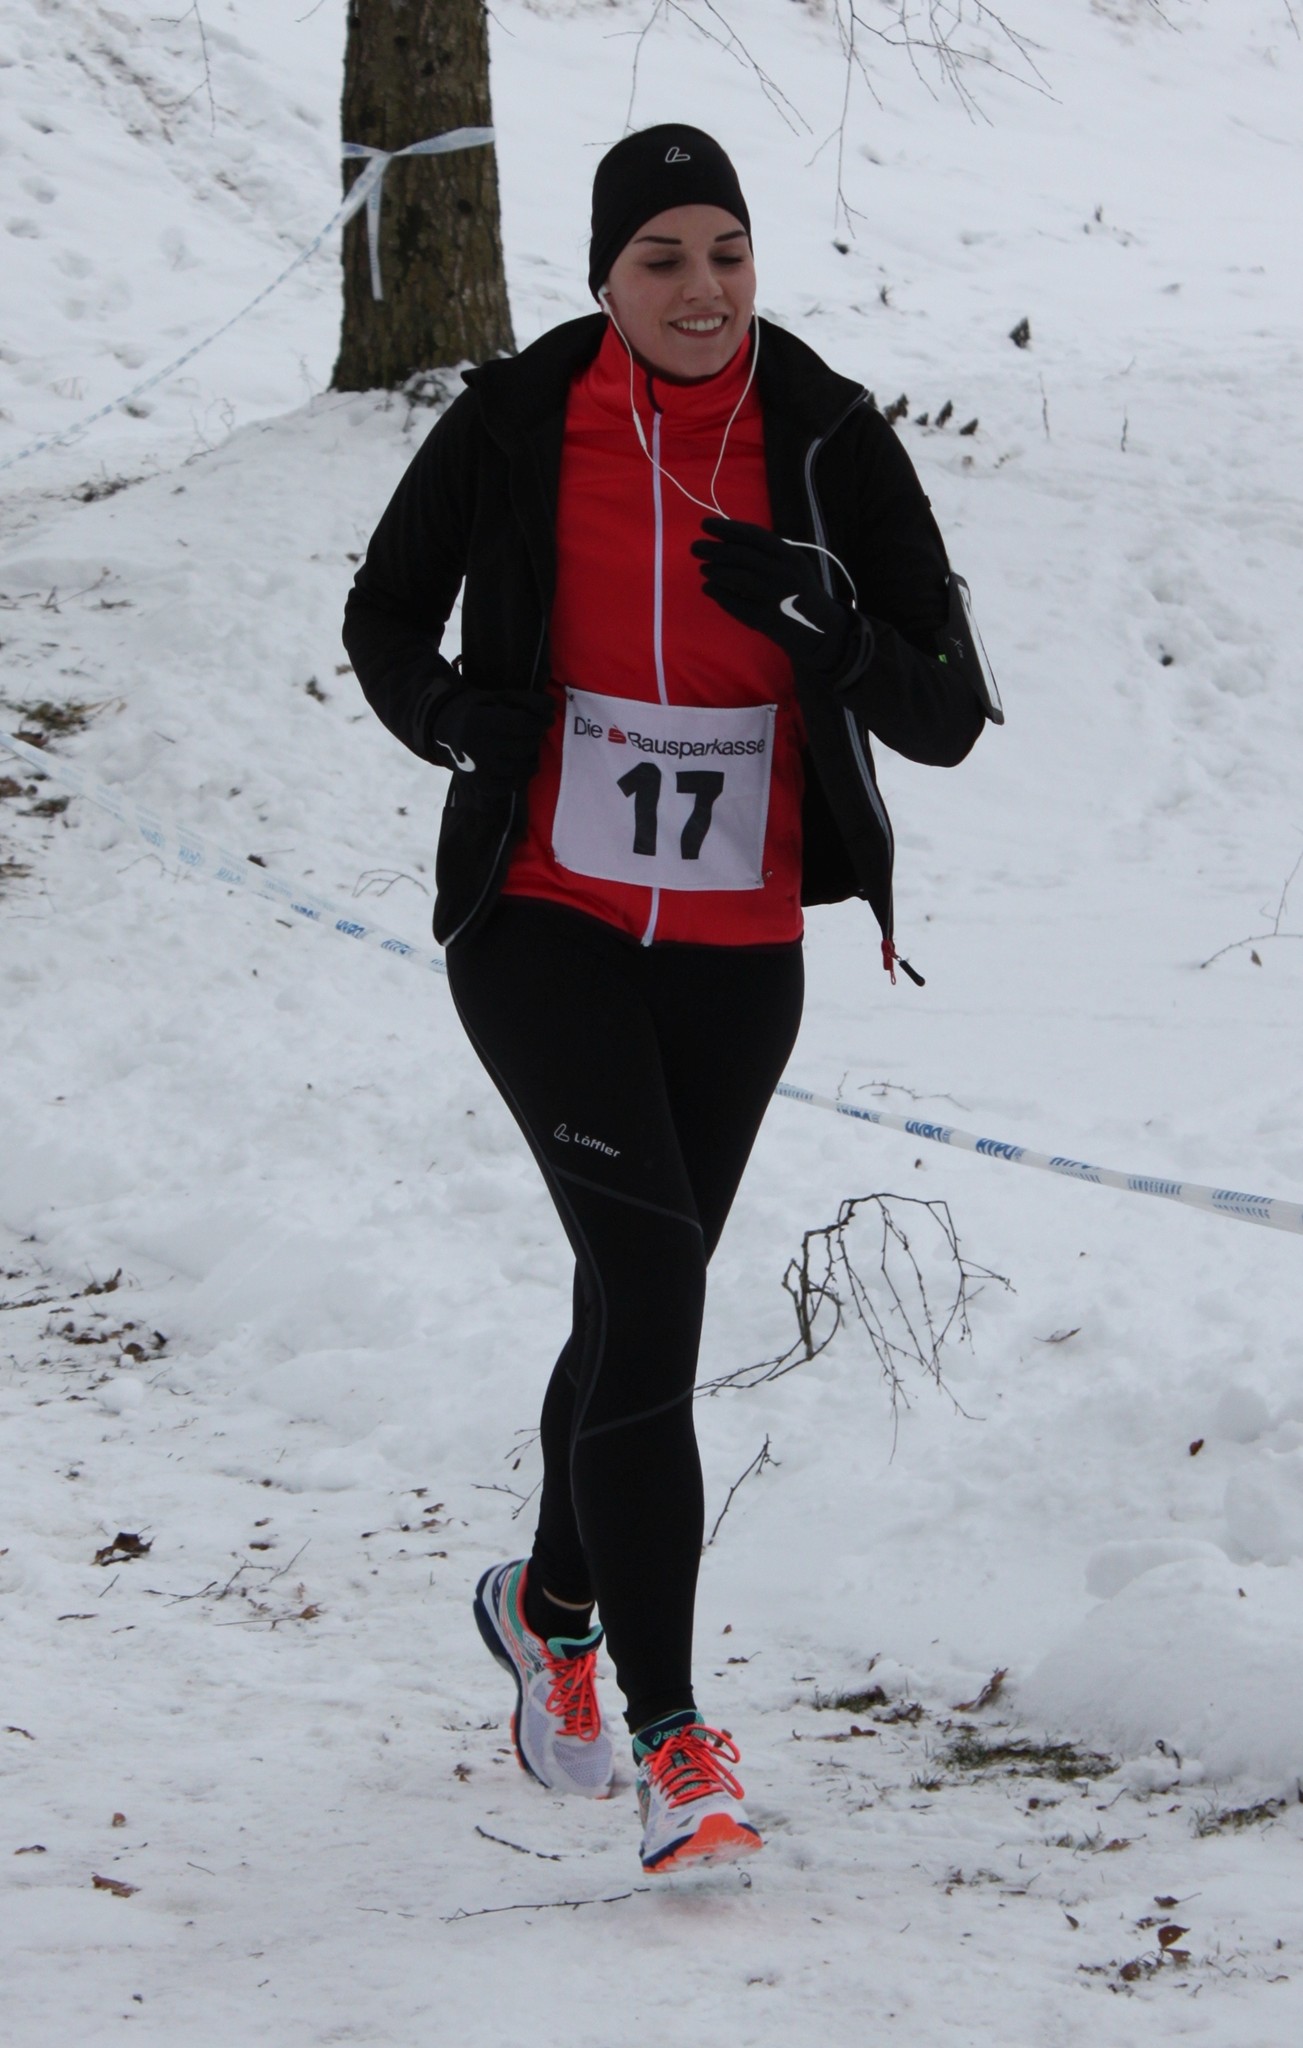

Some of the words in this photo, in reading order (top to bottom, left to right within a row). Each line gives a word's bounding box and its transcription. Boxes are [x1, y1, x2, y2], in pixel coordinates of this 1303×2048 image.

[573, 716, 603, 739] Die
[616, 761, 725, 861] 17
[574, 1132, 621, 1157] Löffler
